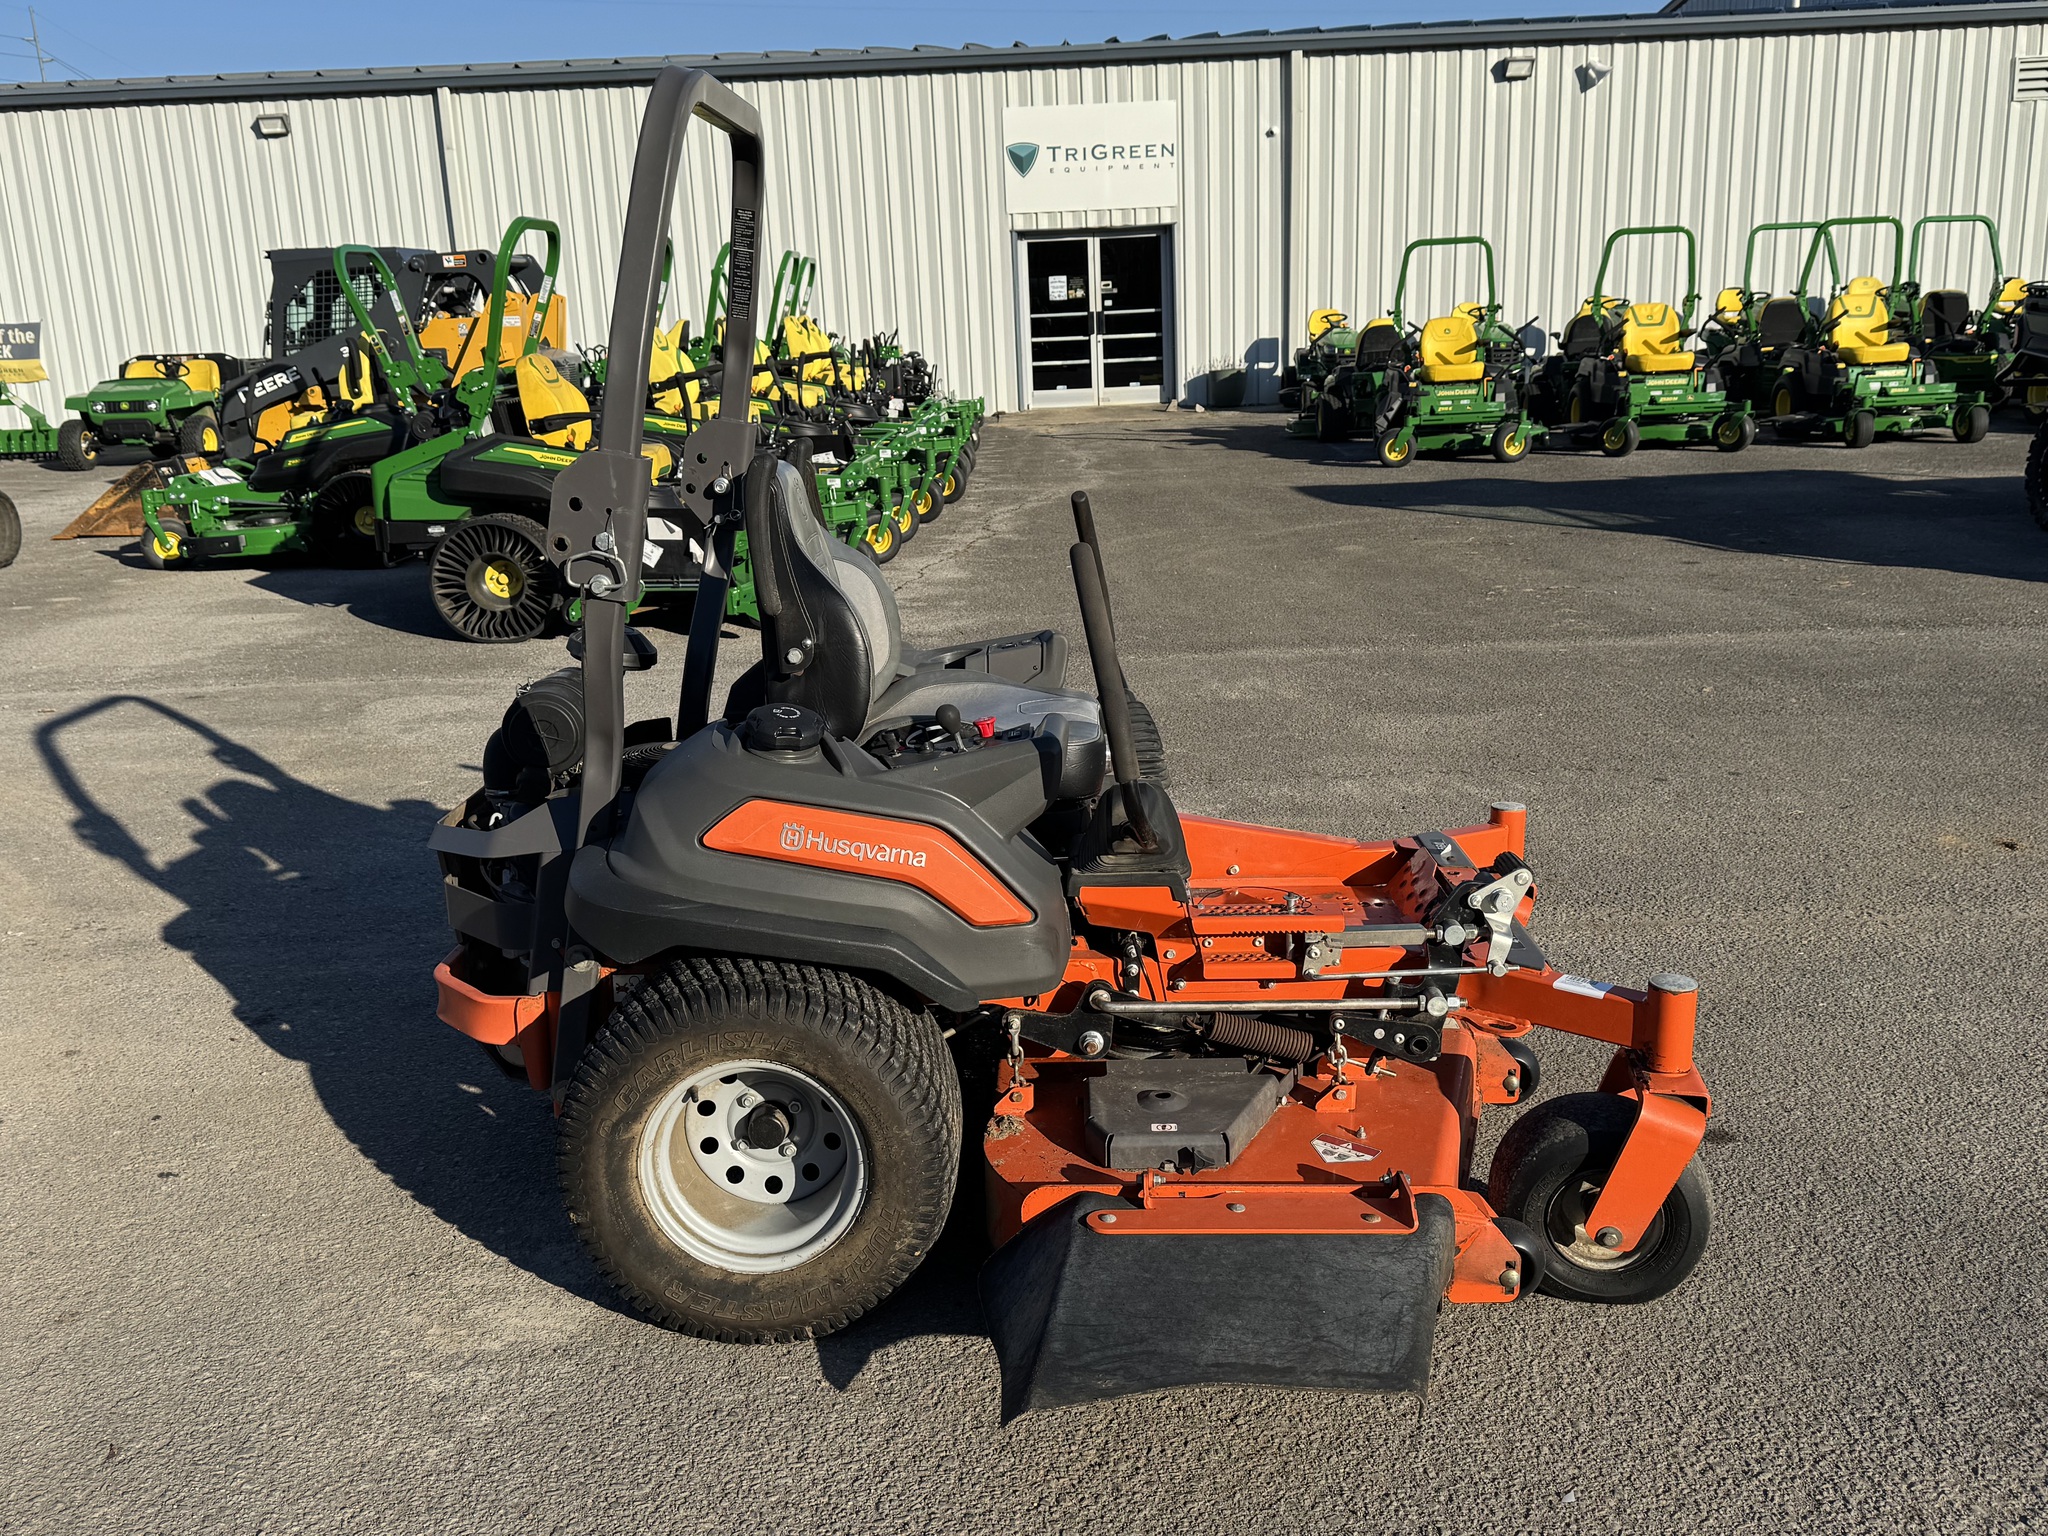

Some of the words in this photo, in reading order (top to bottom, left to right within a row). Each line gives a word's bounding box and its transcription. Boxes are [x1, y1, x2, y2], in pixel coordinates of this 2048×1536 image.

[1049, 162, 1175, 174] EQUIPMENT
[7, 327, 36, 344] the
[1665, 377, 1689, 385] DEERE
[1436, 389, 1455, 397] JOHN
[1455, 387, 1479, 395] DEERE
[540, 453, 556, 461] JOHN
[556, 454, 574, 463] DEER
[805, 829, 928, 868] Husqvarna
[614, 1030, 805, 1113] CARLISLE
[842, 1206, 901, 1293] TURF
[663, 1279, 833, 1321] MASTER
